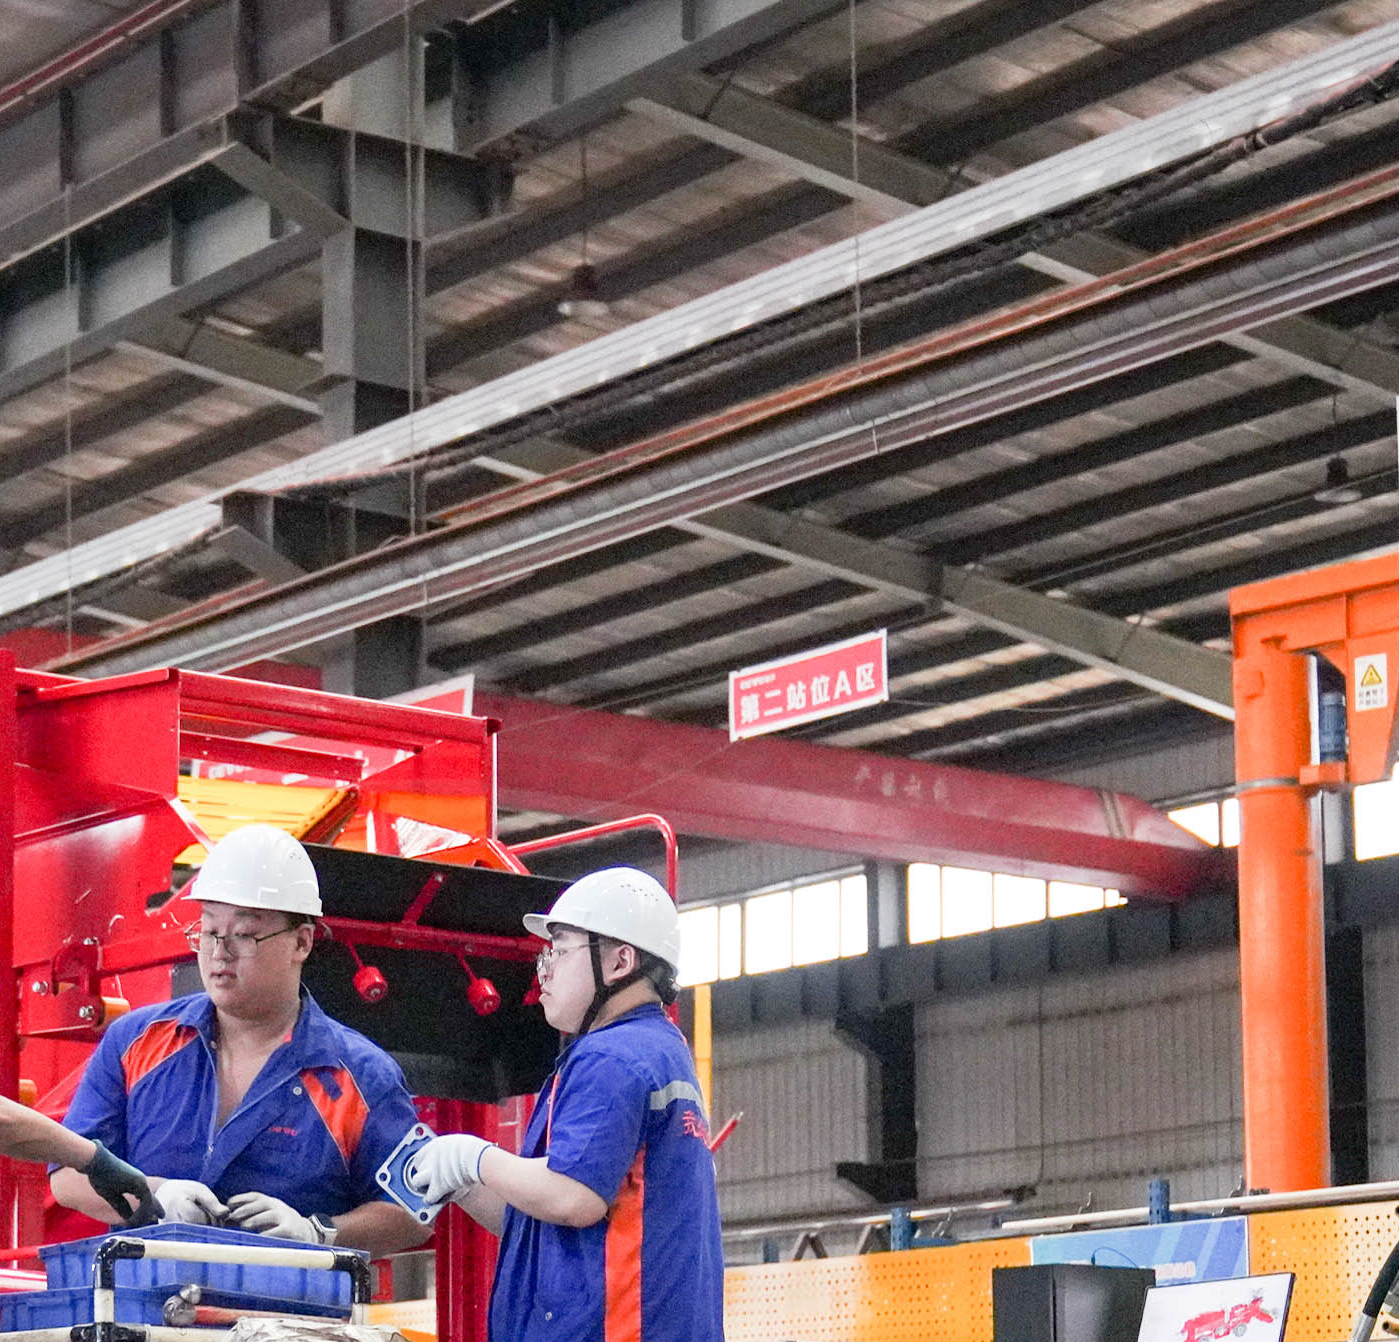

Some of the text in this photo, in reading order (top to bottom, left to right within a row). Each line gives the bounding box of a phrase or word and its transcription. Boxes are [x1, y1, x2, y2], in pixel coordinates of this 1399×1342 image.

[740, 662, 876, 724] 第二站位A区
